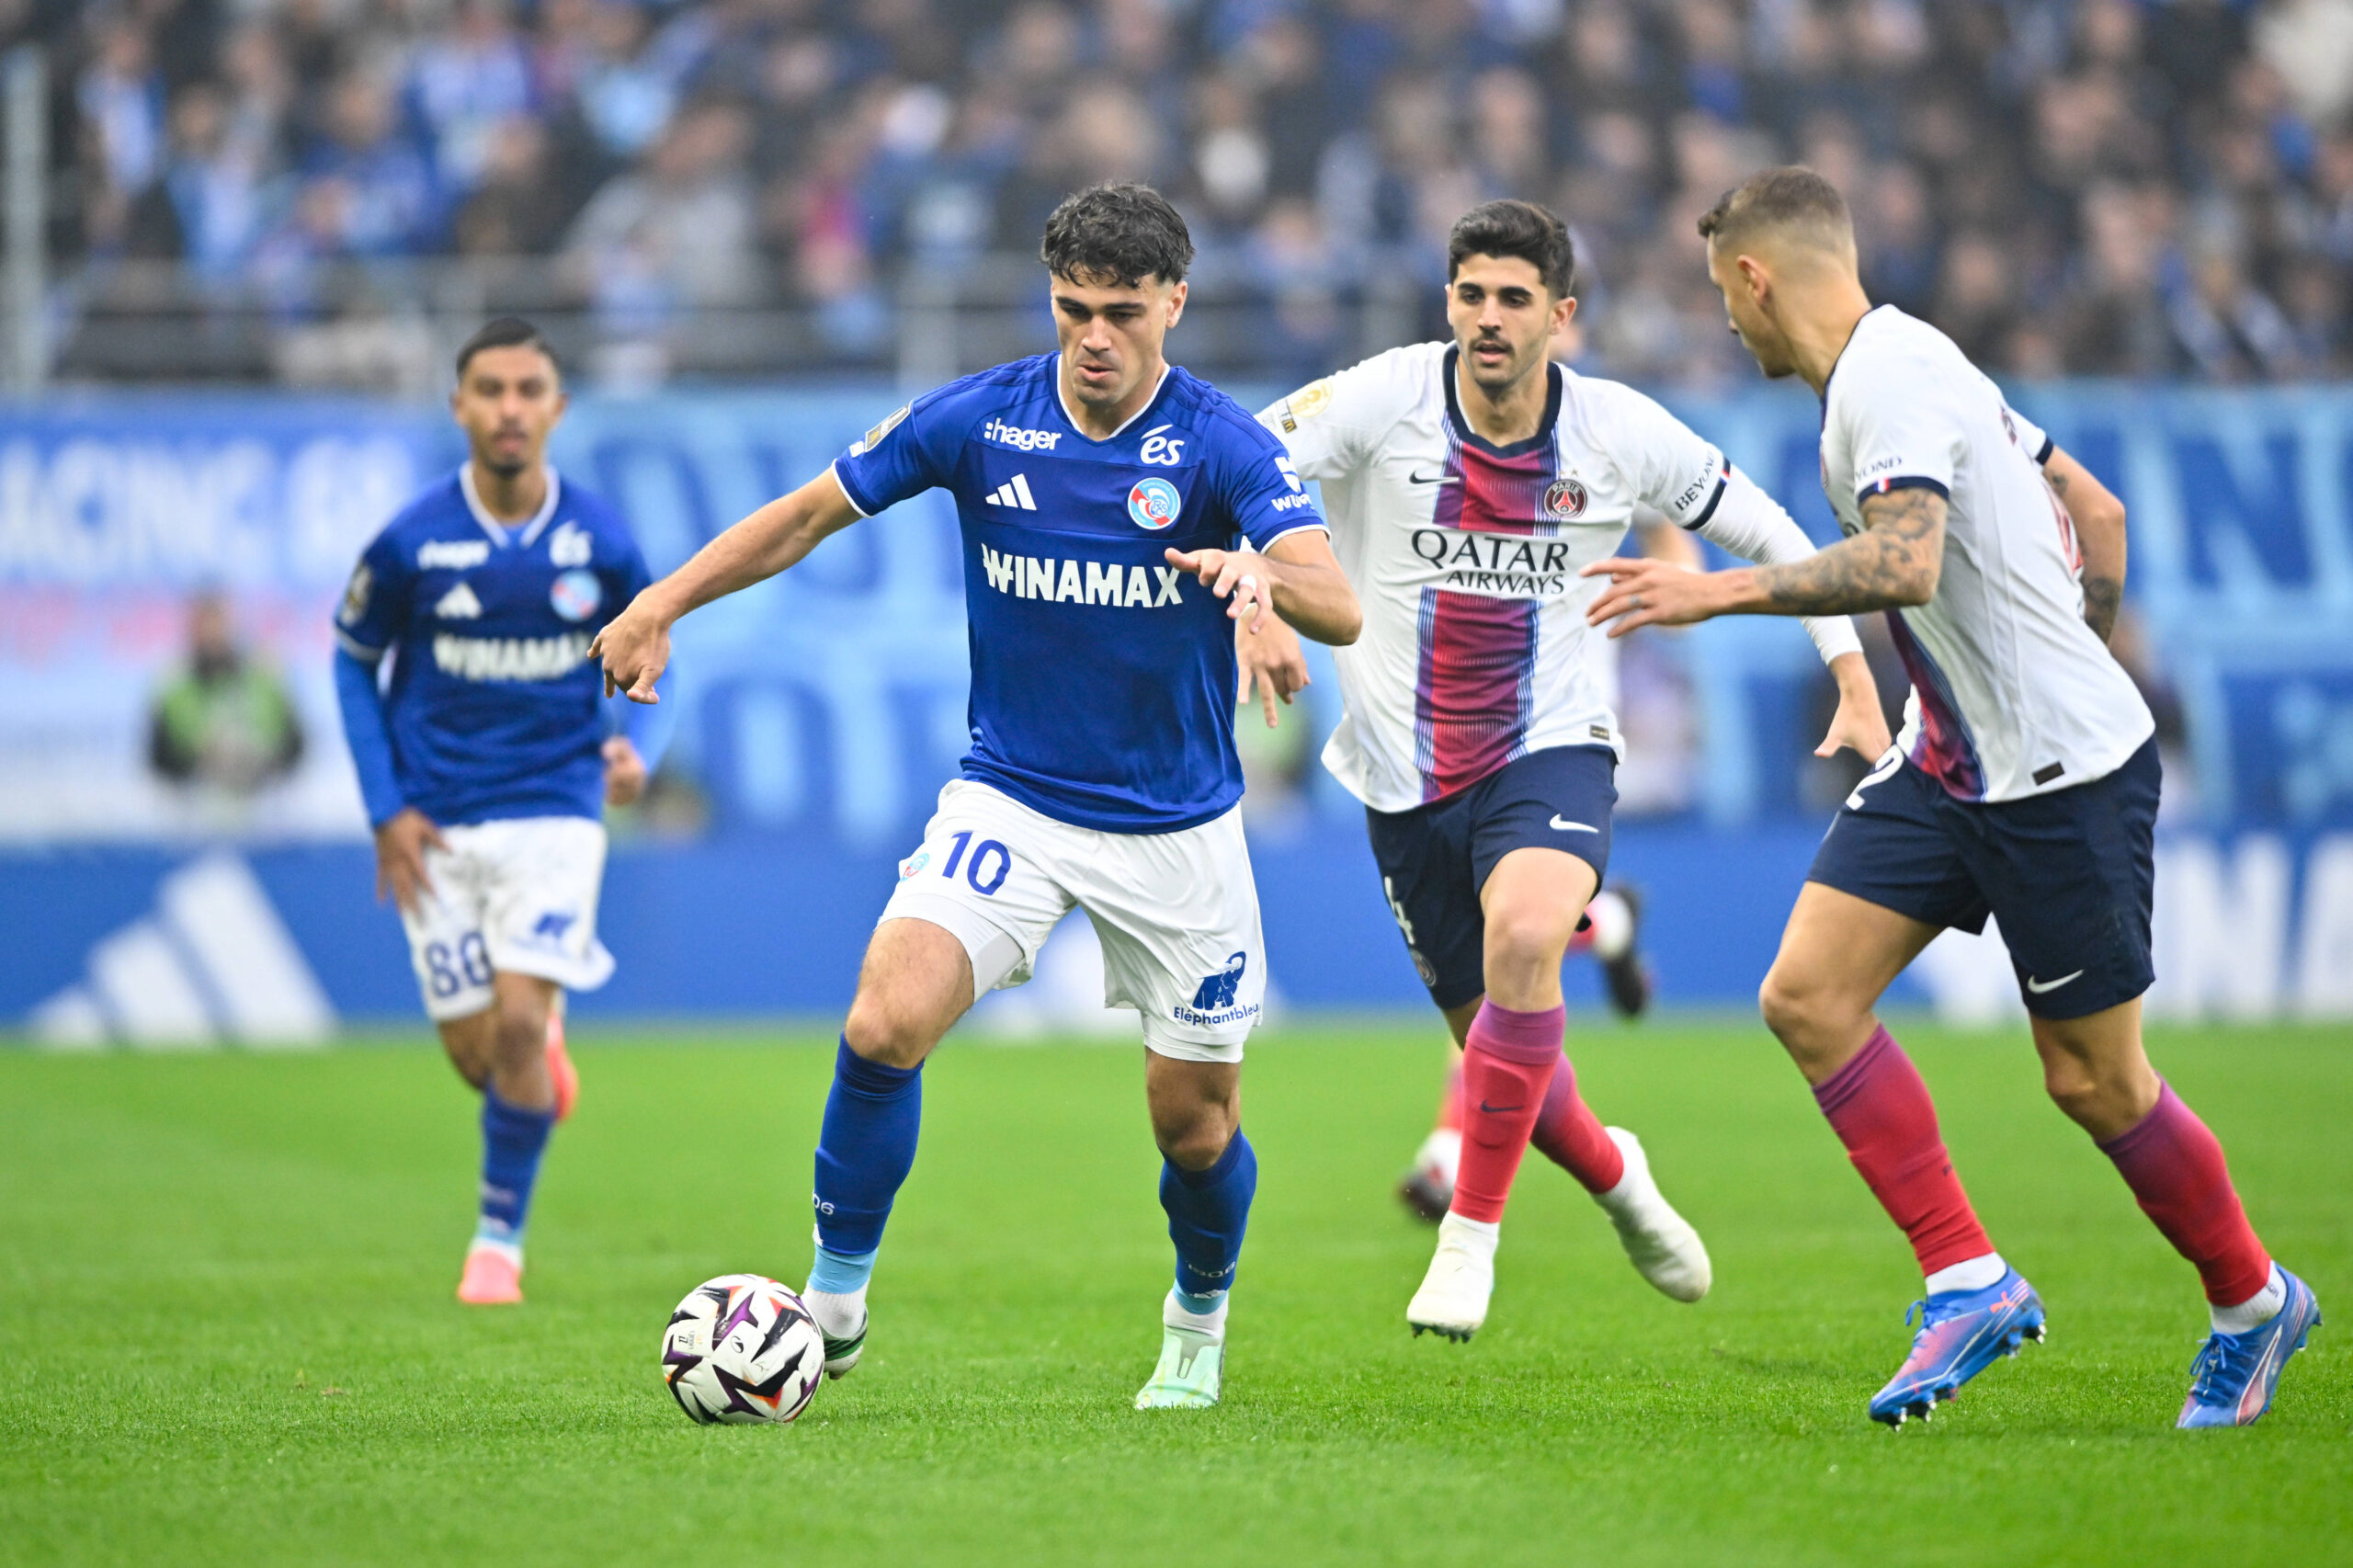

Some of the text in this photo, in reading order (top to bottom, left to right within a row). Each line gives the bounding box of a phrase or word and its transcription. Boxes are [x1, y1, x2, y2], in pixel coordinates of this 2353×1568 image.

[1552, 483, 1580, 494] PARIS
[1411, 528, 1570, 573] QATAR
[981, 542, 1184, 608] WINAMAX
[1446, 570, 1565, 596] AIRWAYS
[942, 831, 1011, 896] 10
